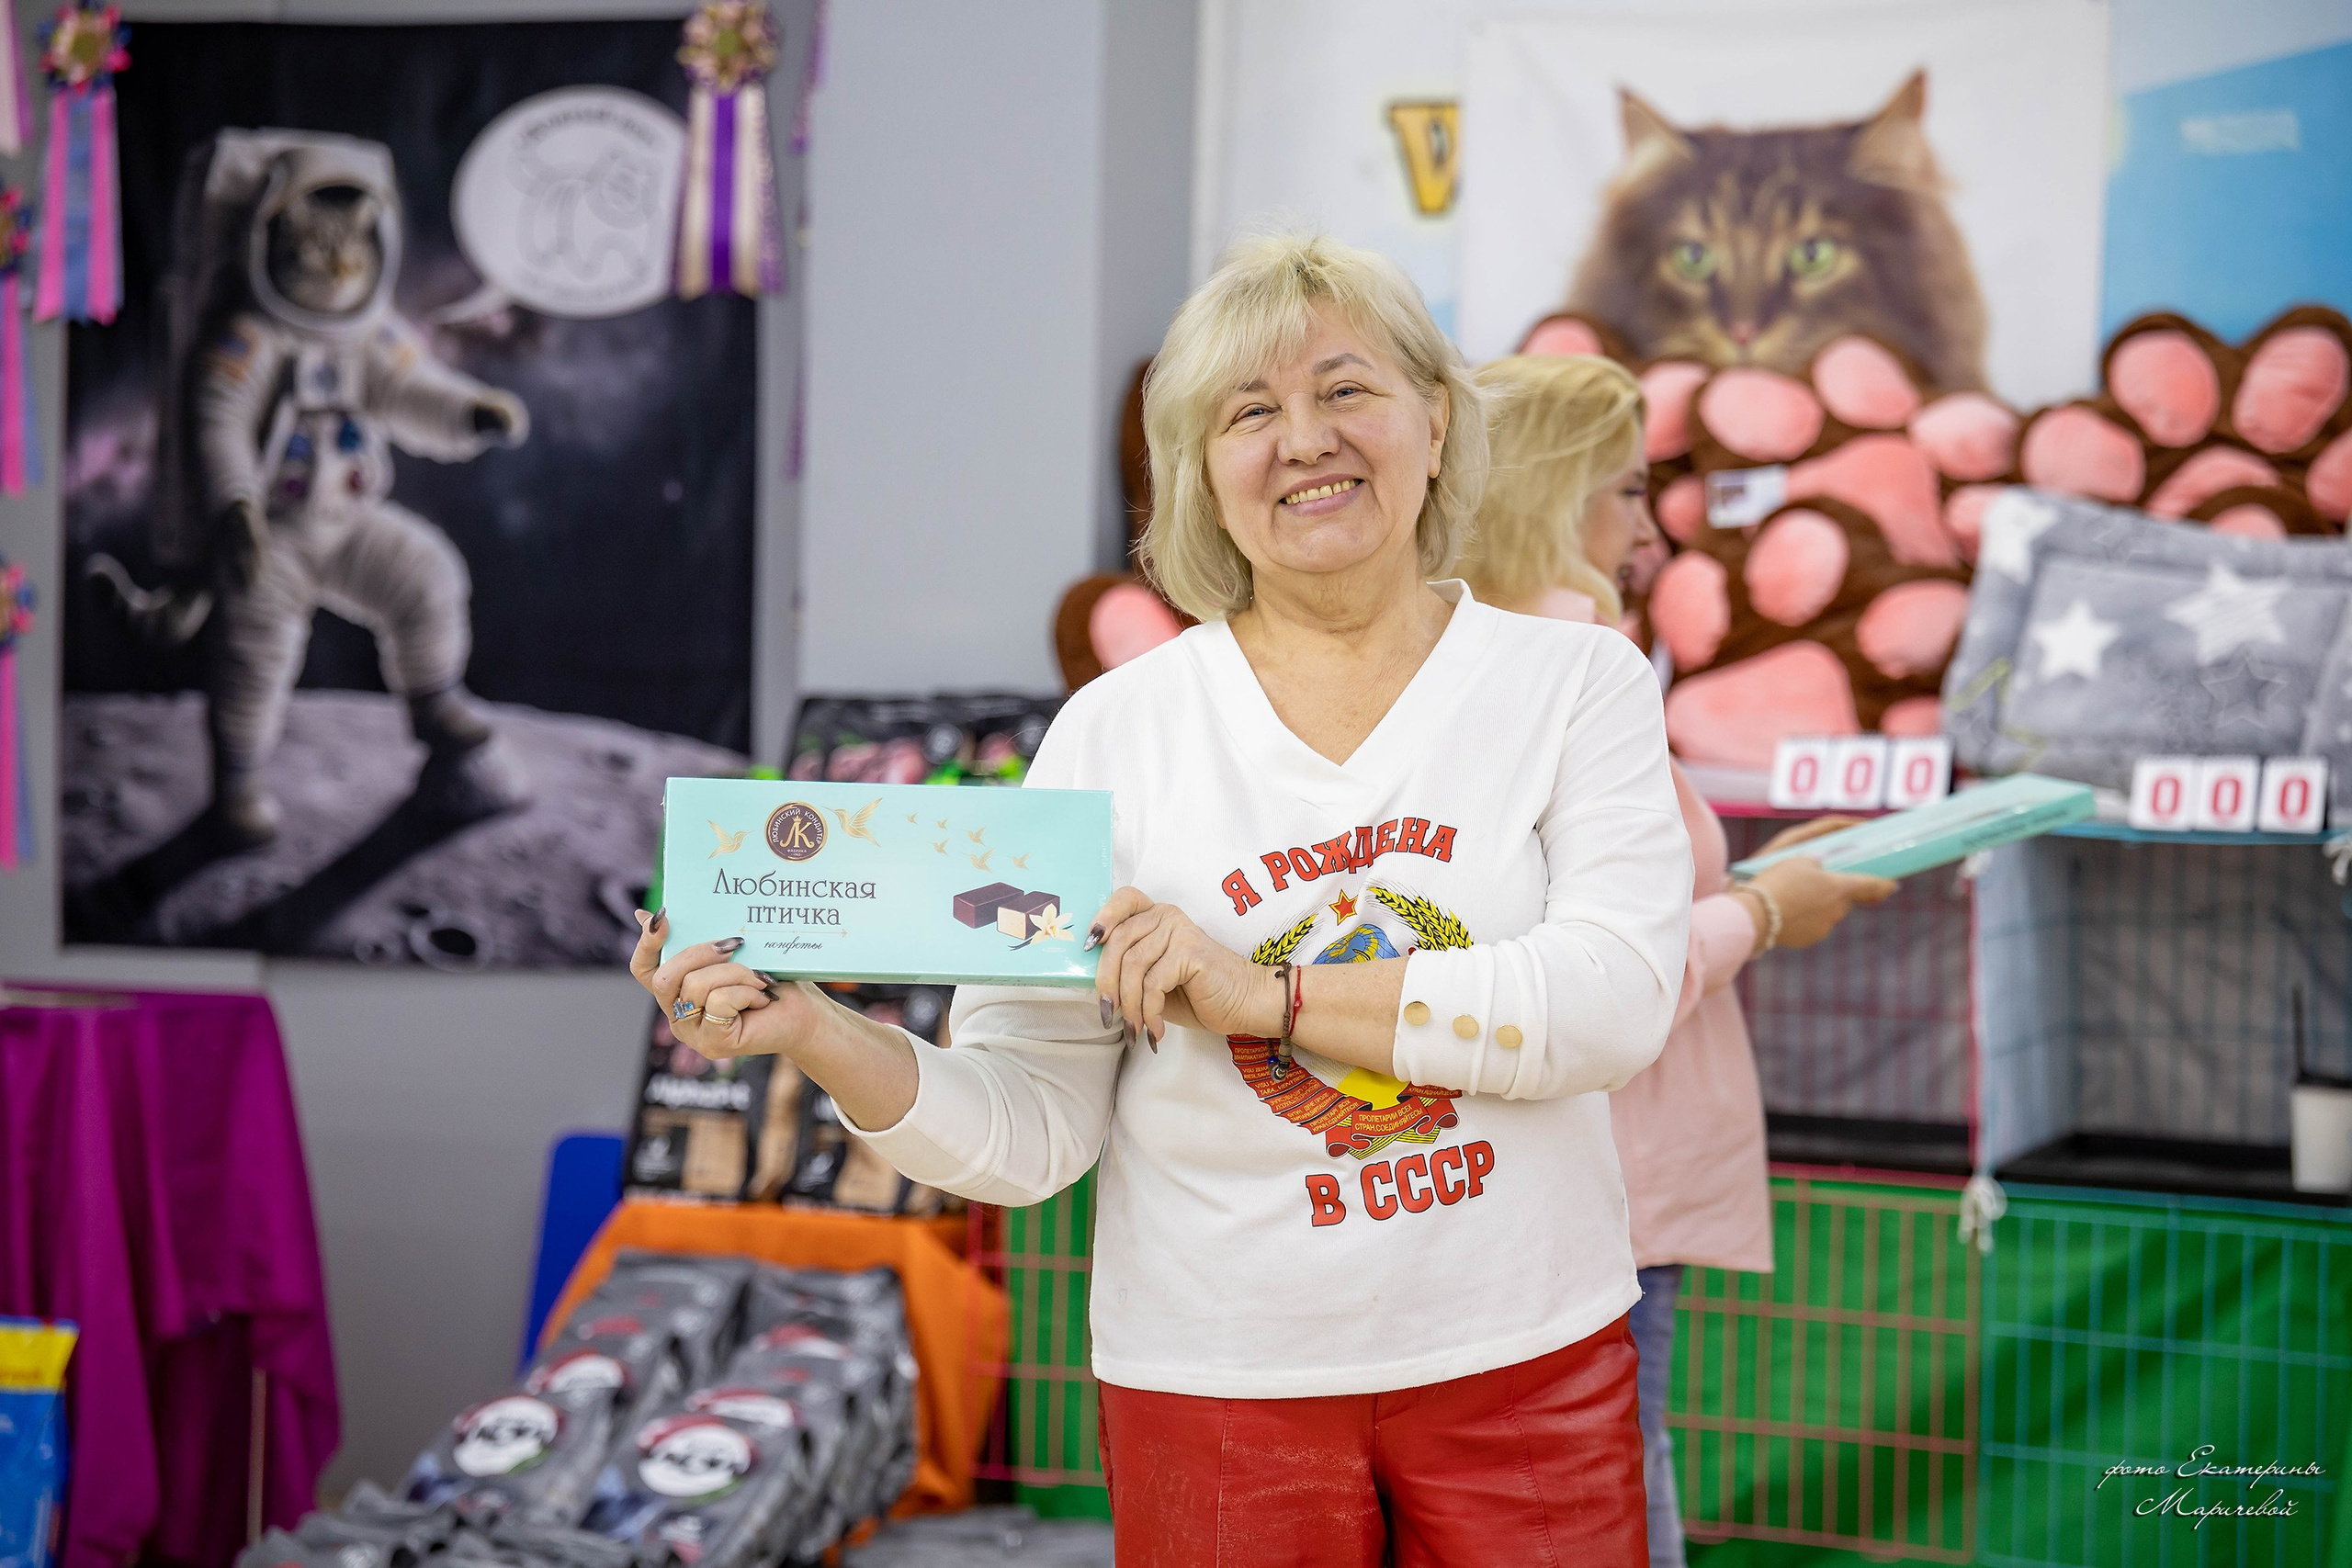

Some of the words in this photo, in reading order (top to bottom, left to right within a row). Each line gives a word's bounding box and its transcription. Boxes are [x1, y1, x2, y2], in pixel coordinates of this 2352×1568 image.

[772, 807, 802, 843] ЛЮБИНСКИЙ
[804, 810, 824, 845] КОНДИТЕР
[1221, 868, 1263, 917] Я
[1260, 817, 1458, 893] РОЖДЕНА
[712, 868, 877, 900] Любинская
[746, 904, 842, 928] птичка
[763, 936, 824, 953] конфеты
[1358, 1112, 1397, 1122] ПРОЛЕТАРИИ
[1397, 1103, 1413, 1117] ВСЕХ
[1305, 1174, 1346, 1227] В
[1360, 1140, 1495, 1221] СССР
